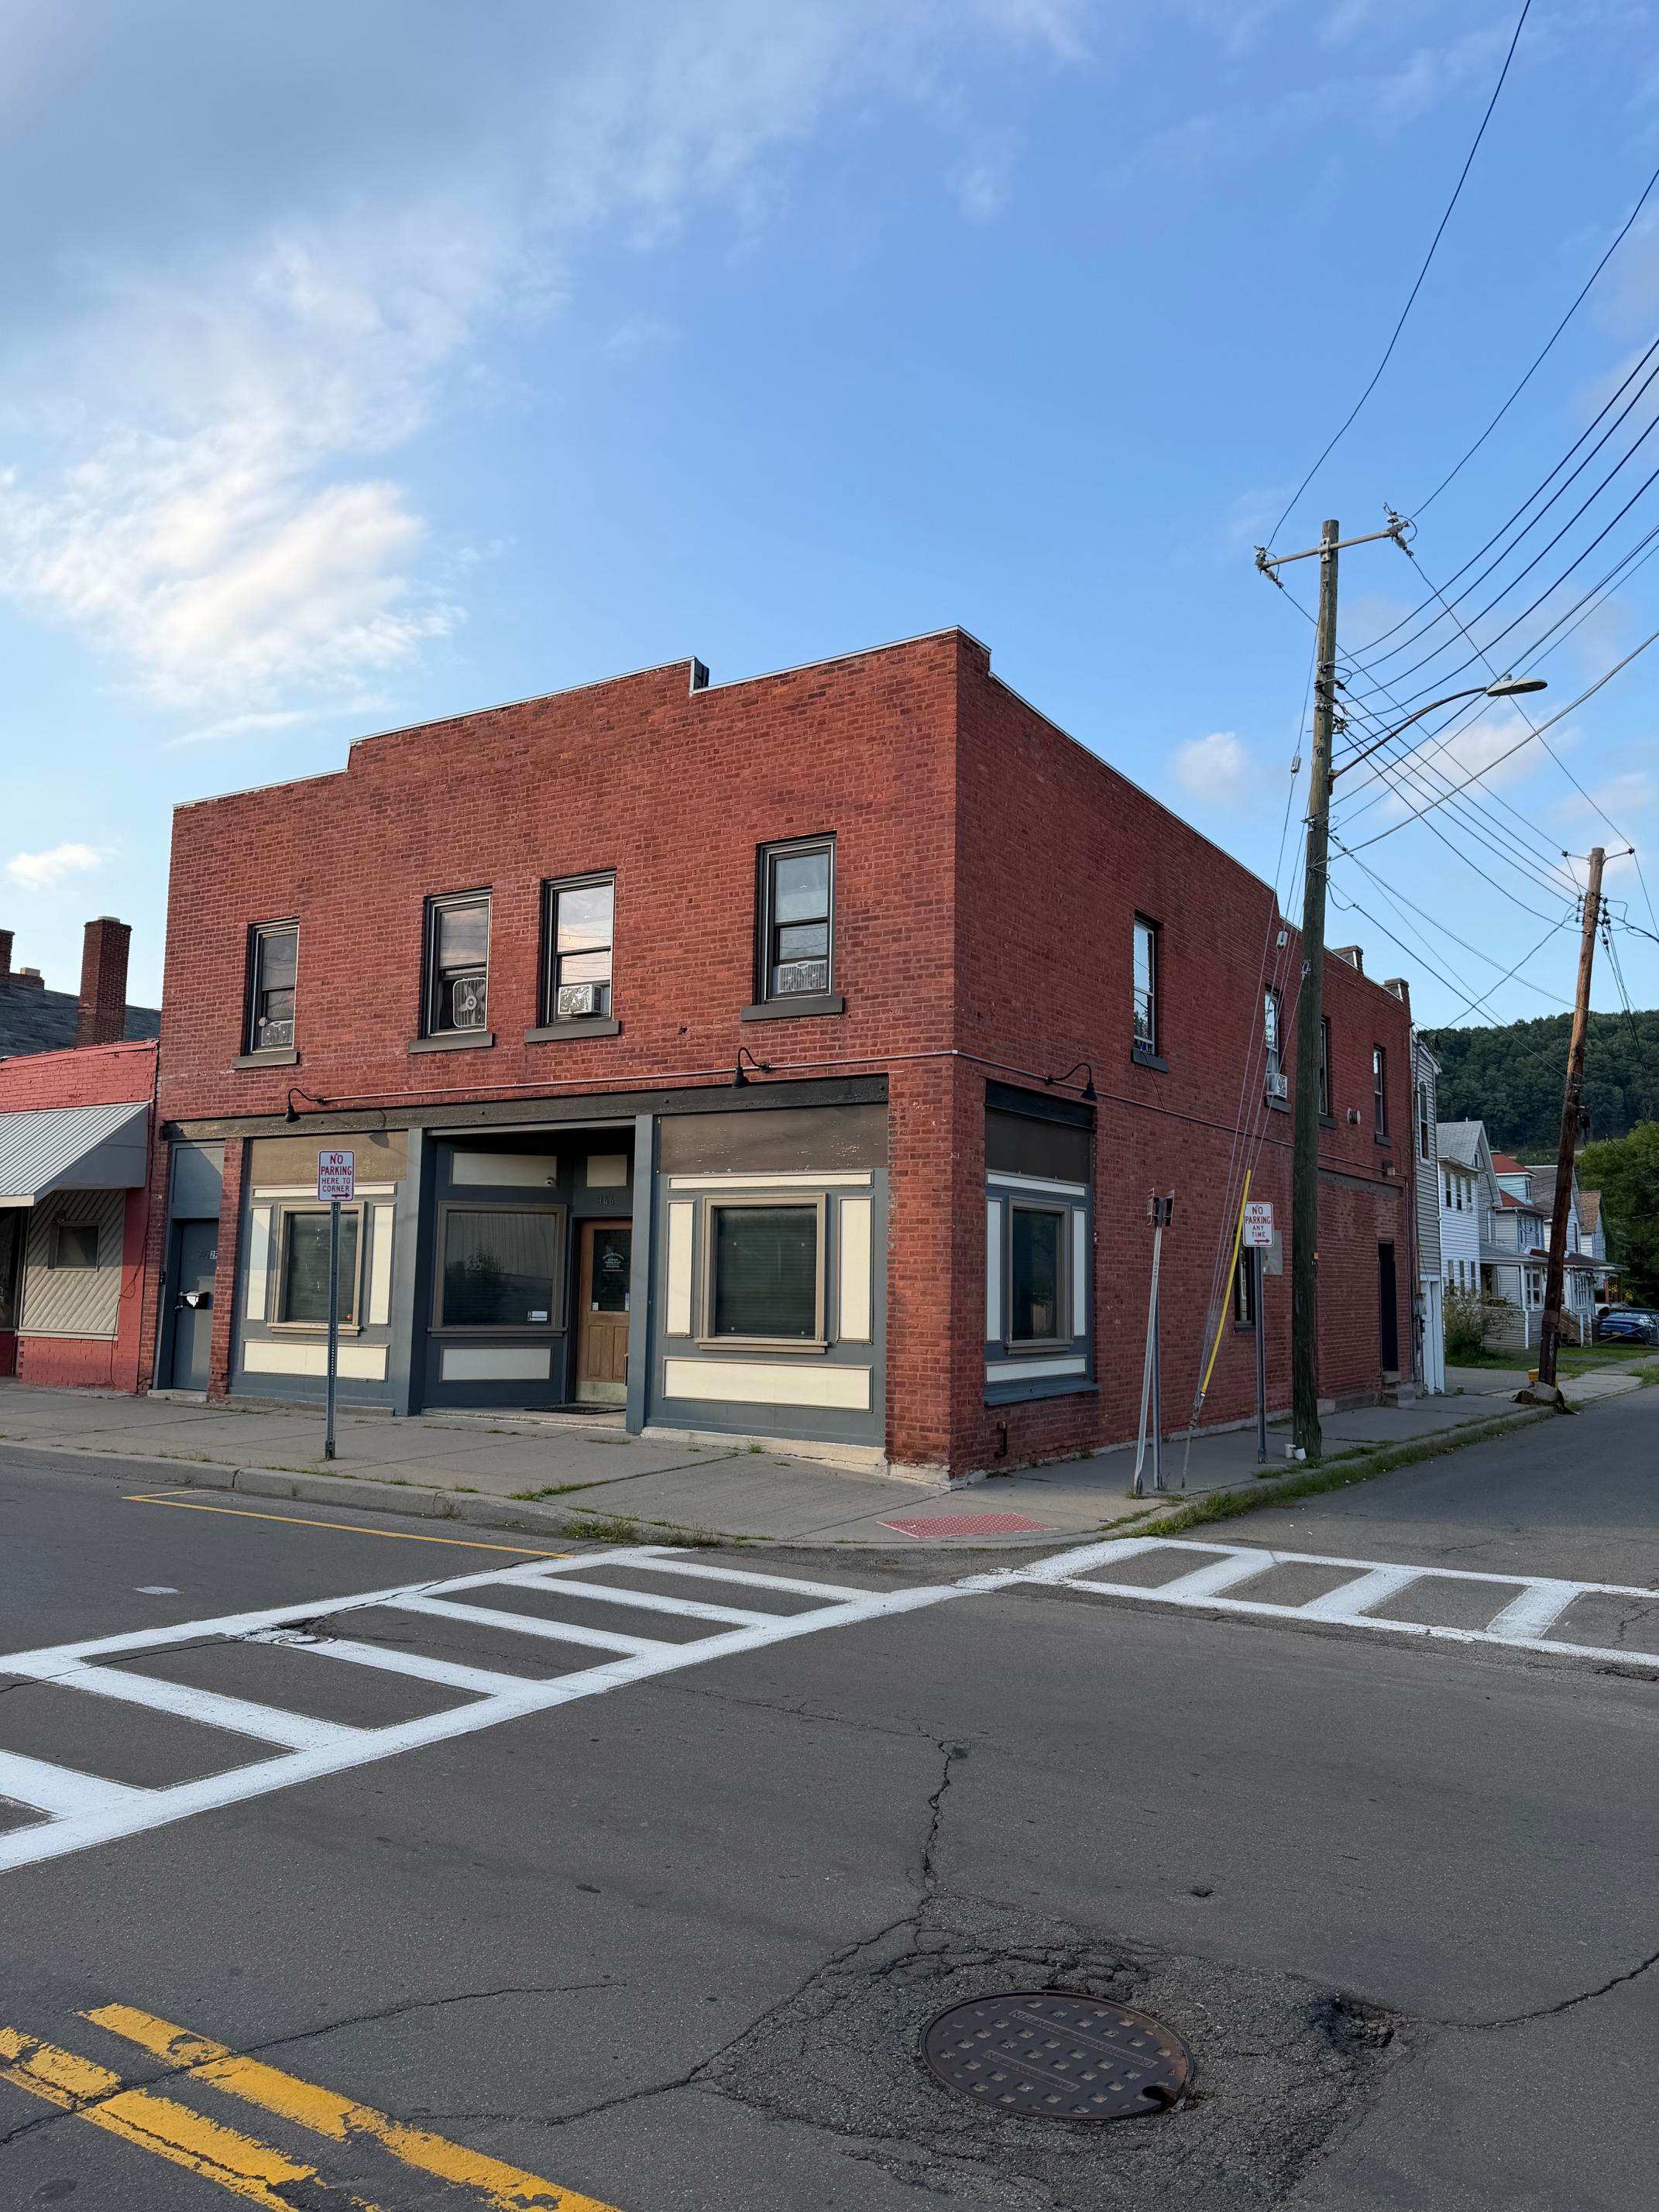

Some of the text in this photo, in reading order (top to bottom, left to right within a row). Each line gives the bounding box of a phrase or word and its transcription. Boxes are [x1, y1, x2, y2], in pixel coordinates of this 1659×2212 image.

[330, 1155, 343, 1164] NO
[321, 1166, 352, 1175] PARKING
[1252, 1206, 1263, 1214] NO
[1245, 1216, 1270, 1224] PARKING
